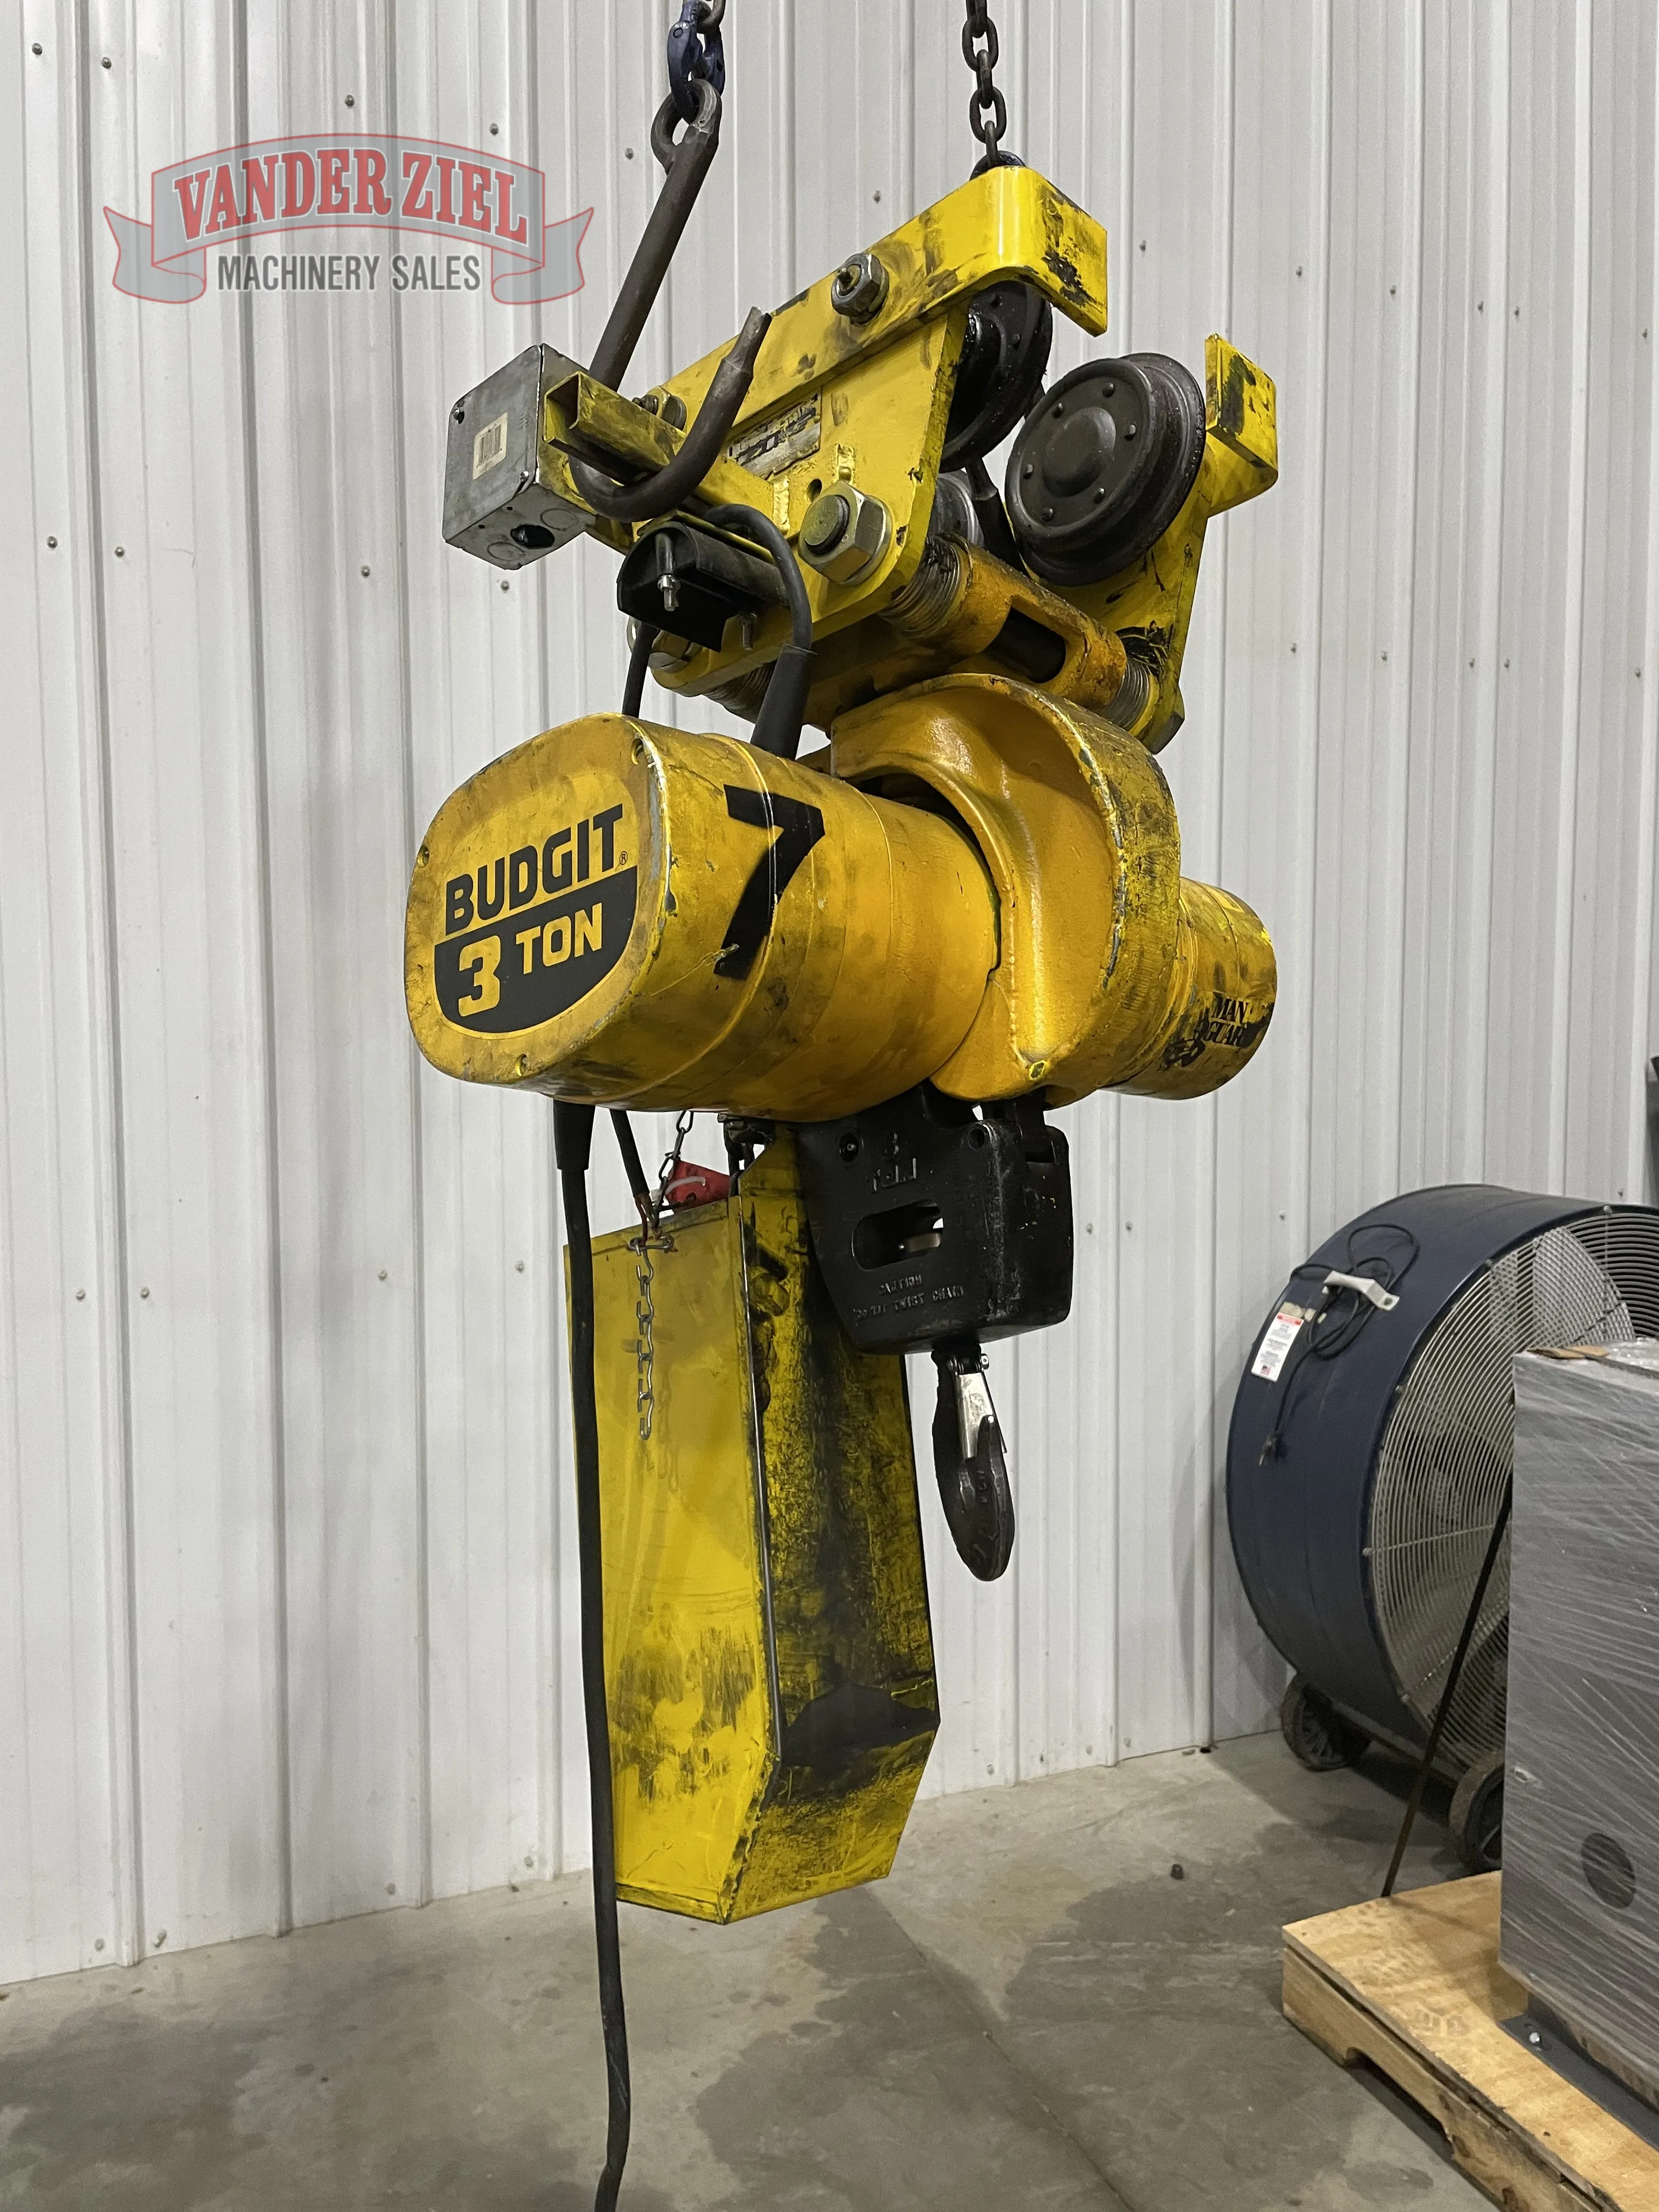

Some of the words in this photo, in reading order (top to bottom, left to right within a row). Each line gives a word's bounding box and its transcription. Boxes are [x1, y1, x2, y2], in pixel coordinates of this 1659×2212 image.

[458, 935, 501, 1017] 3
[516, 902, 603, 975] TON
[714, 784, 825, 981] 7
